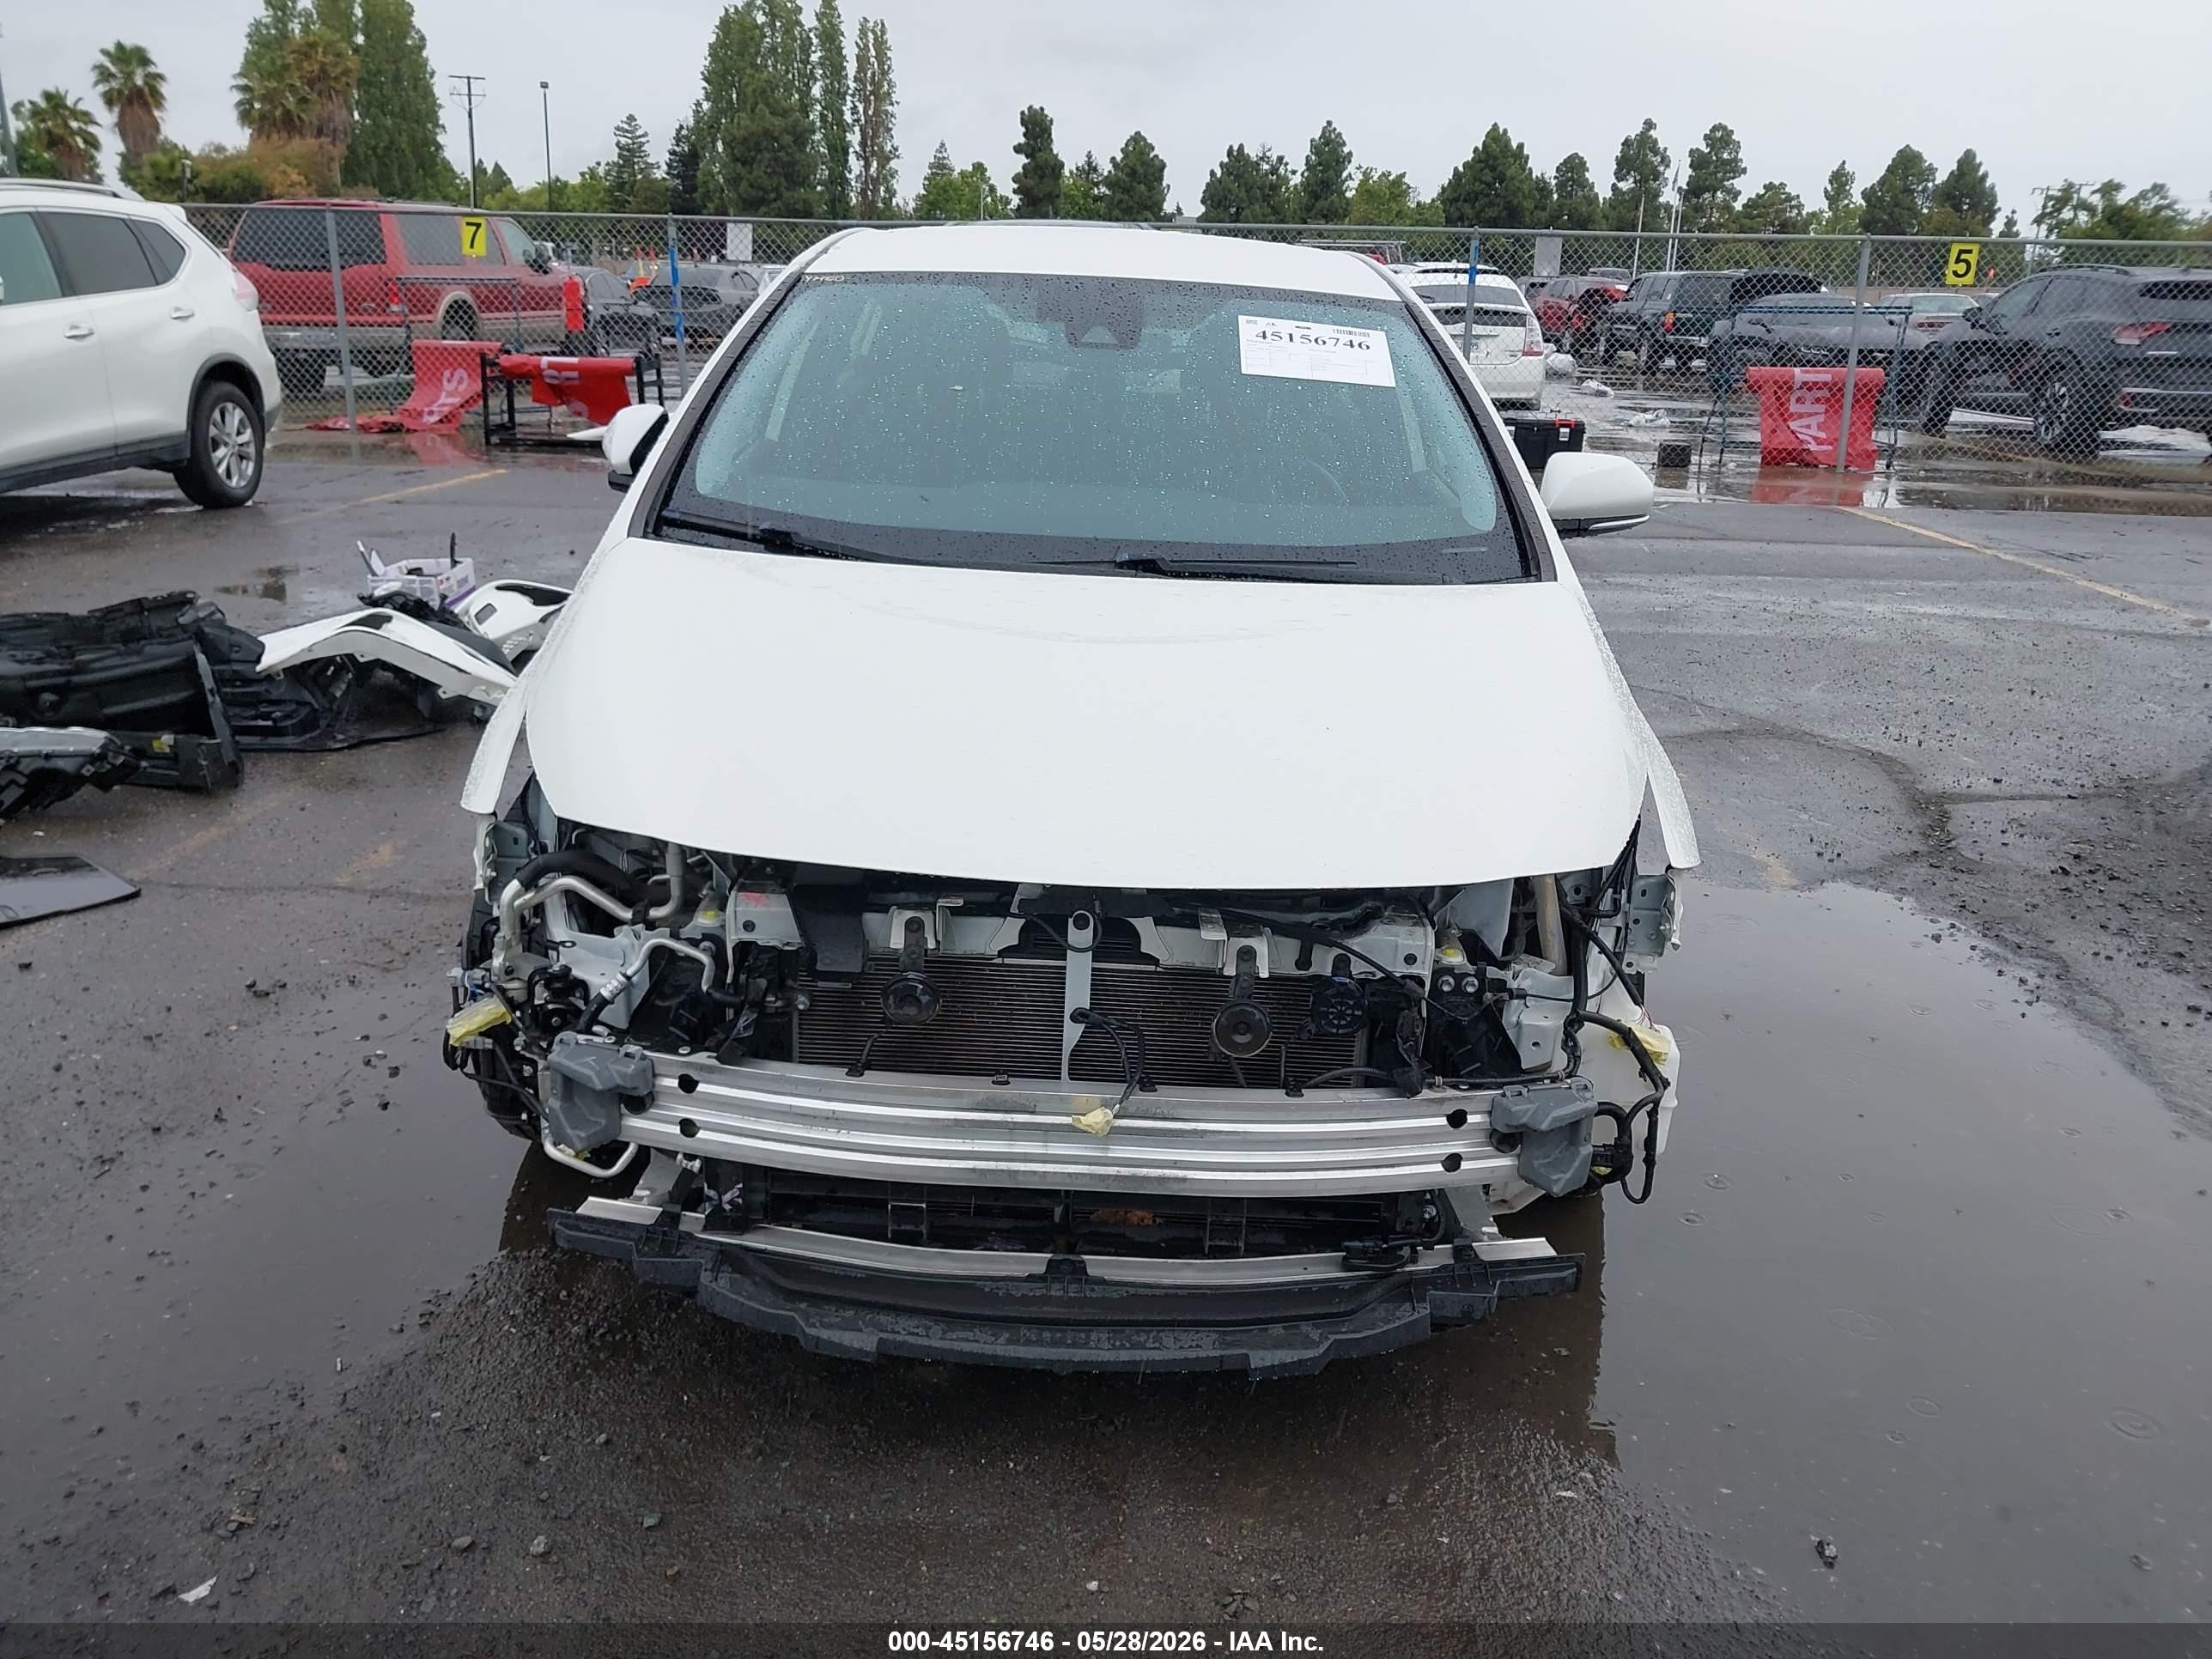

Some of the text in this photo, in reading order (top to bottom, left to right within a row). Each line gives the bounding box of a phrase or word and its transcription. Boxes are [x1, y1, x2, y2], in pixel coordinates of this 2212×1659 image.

[465, 221, 482, 249] 7
[1952, 249, 1973, 278] 5
[1255, 330, 1370, 351] 45156746
